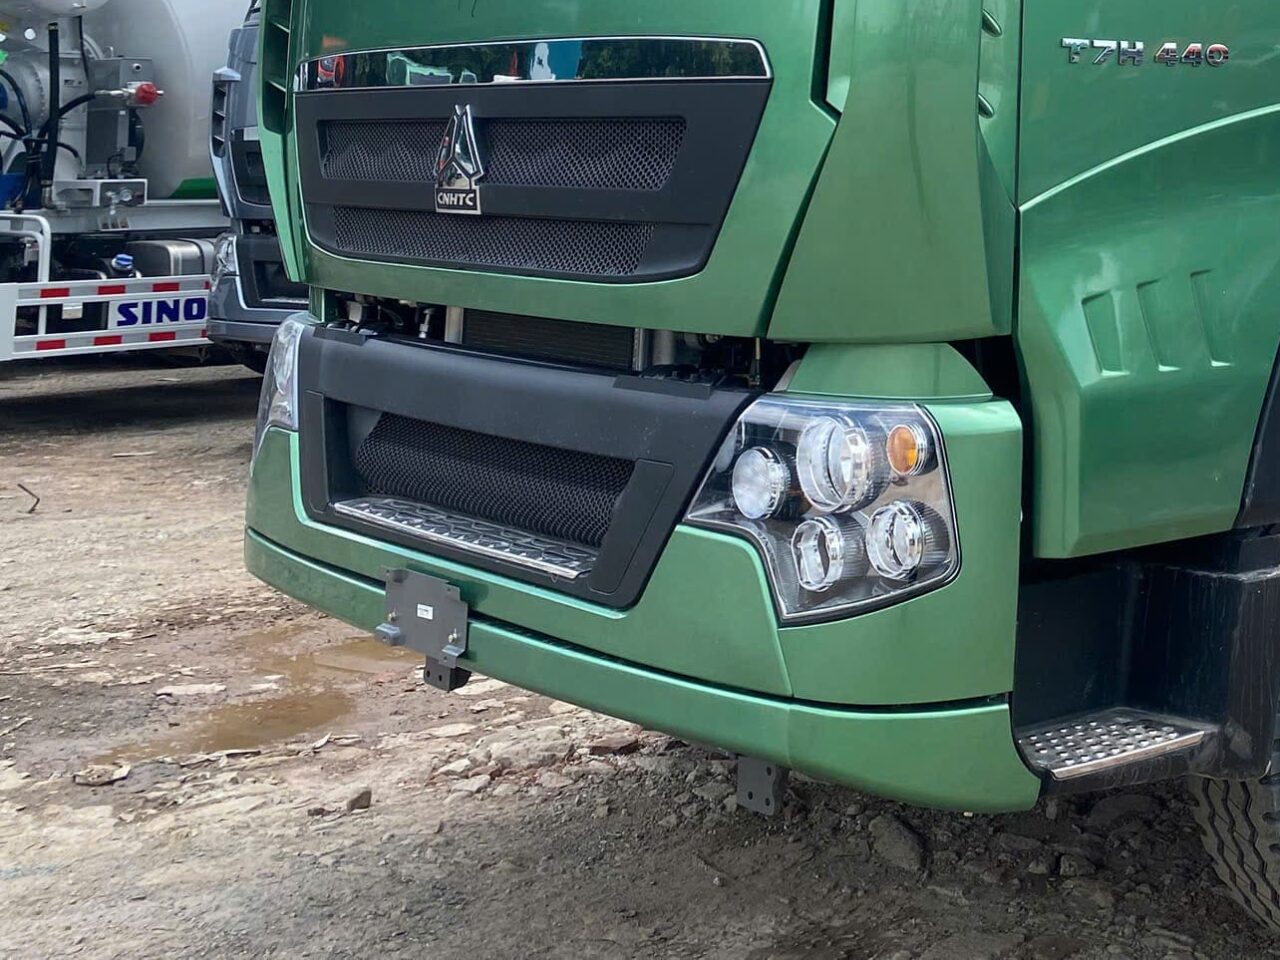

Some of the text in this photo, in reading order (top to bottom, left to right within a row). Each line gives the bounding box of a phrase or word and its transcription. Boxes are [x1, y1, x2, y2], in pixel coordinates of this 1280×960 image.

[1061, 38, 1229, 68] T7H 440
[437, 192, 474, 206] CNHTC
[117, 297, 207, 327] SINO
